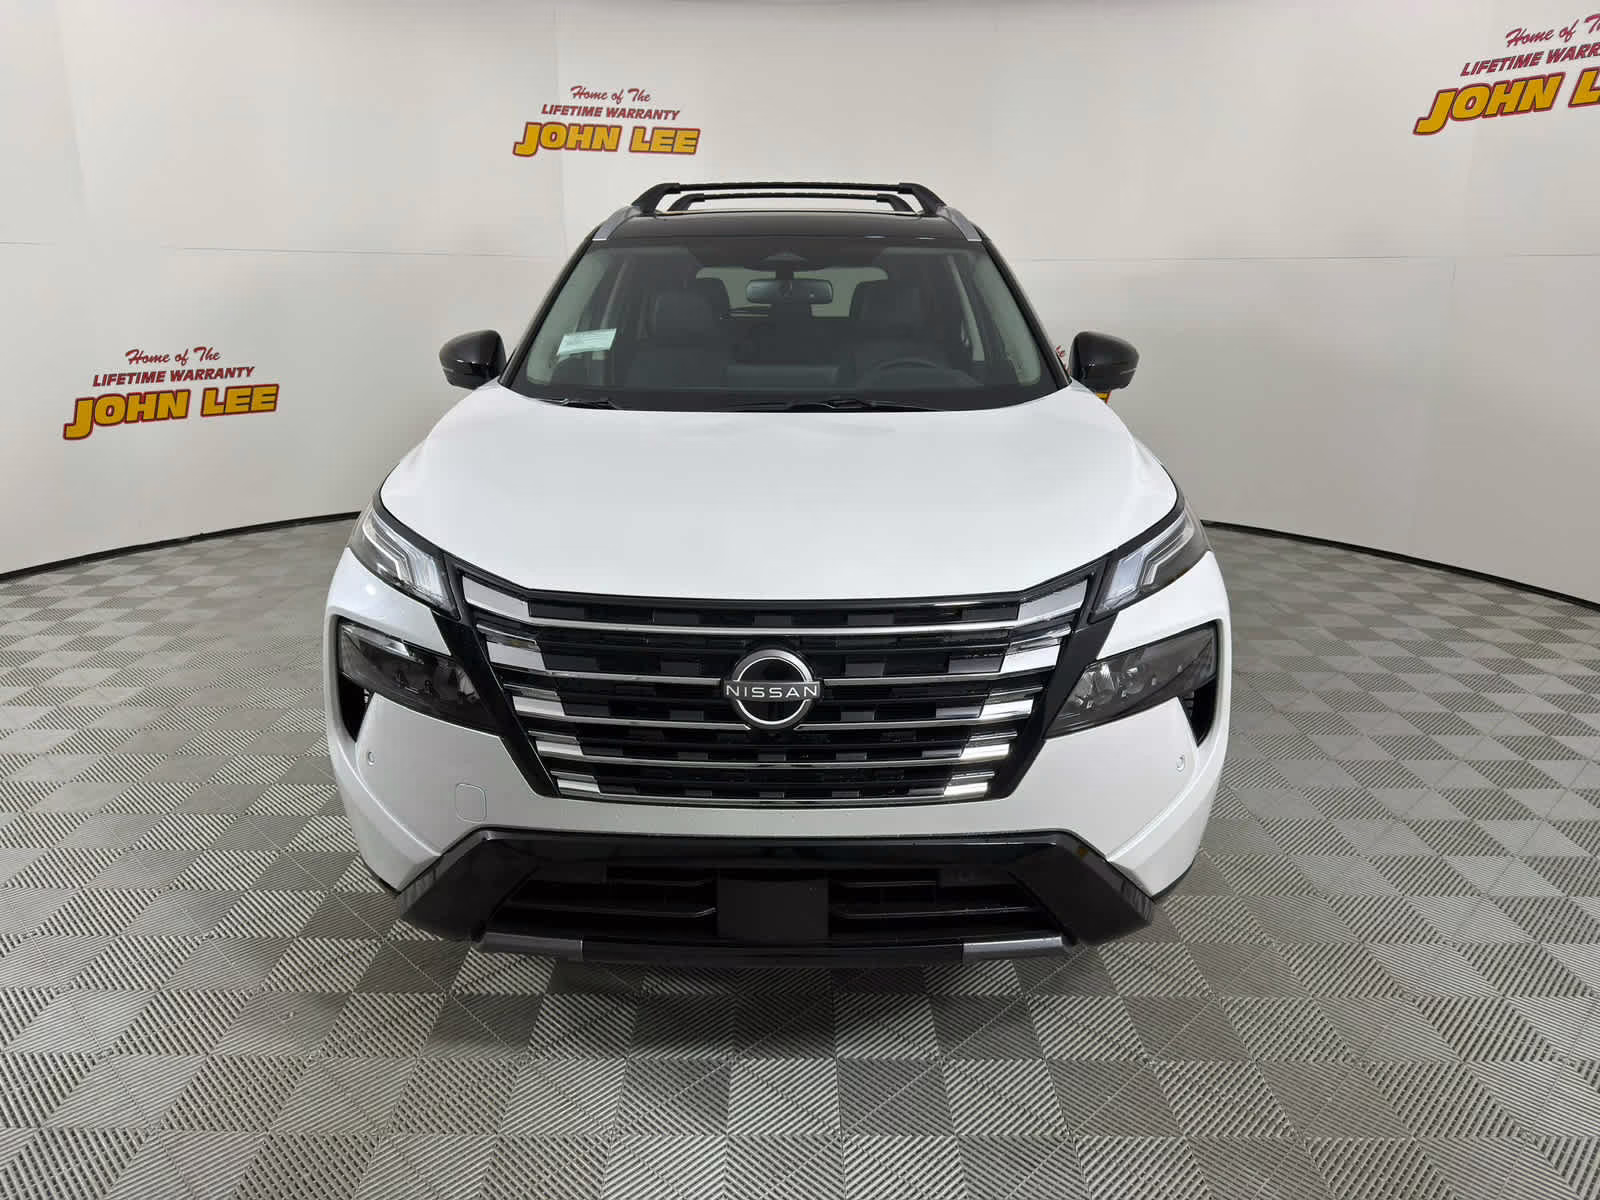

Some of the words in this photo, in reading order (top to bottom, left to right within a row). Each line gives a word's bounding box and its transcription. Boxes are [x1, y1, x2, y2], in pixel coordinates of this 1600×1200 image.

[1506, 28, 1554, 48] Home
[1559, 19, 1579, 43] of
[1584, 13, 1600, 33] T
[1460, 51, 1544, 77] LIFETIME
[571, 85, 608, 99] Home
[611, 89, 625, 104] of
[627, 88, 651, 102] The
[1413, 72, 1566, 135] JOHN
[541, 104, 603, 118] LIFETIME
[606, 107, 680, 120] WARRANTY
[513, 121, 623, 157] JOHN
[629, 126, 701, 155] LEE
[125, 349, 170, 364] Home
[174, 349, 190, 366] of
[193, 346, 221, 361] The
[92, 371, 166, 387] LIFETIME
[170, 366, 255, 382] WARRANTY
[63, 389, 191, 440] JOHN
[200, 384, 279, 416] LEE
[726, 684, 817, 698] NISSAN
